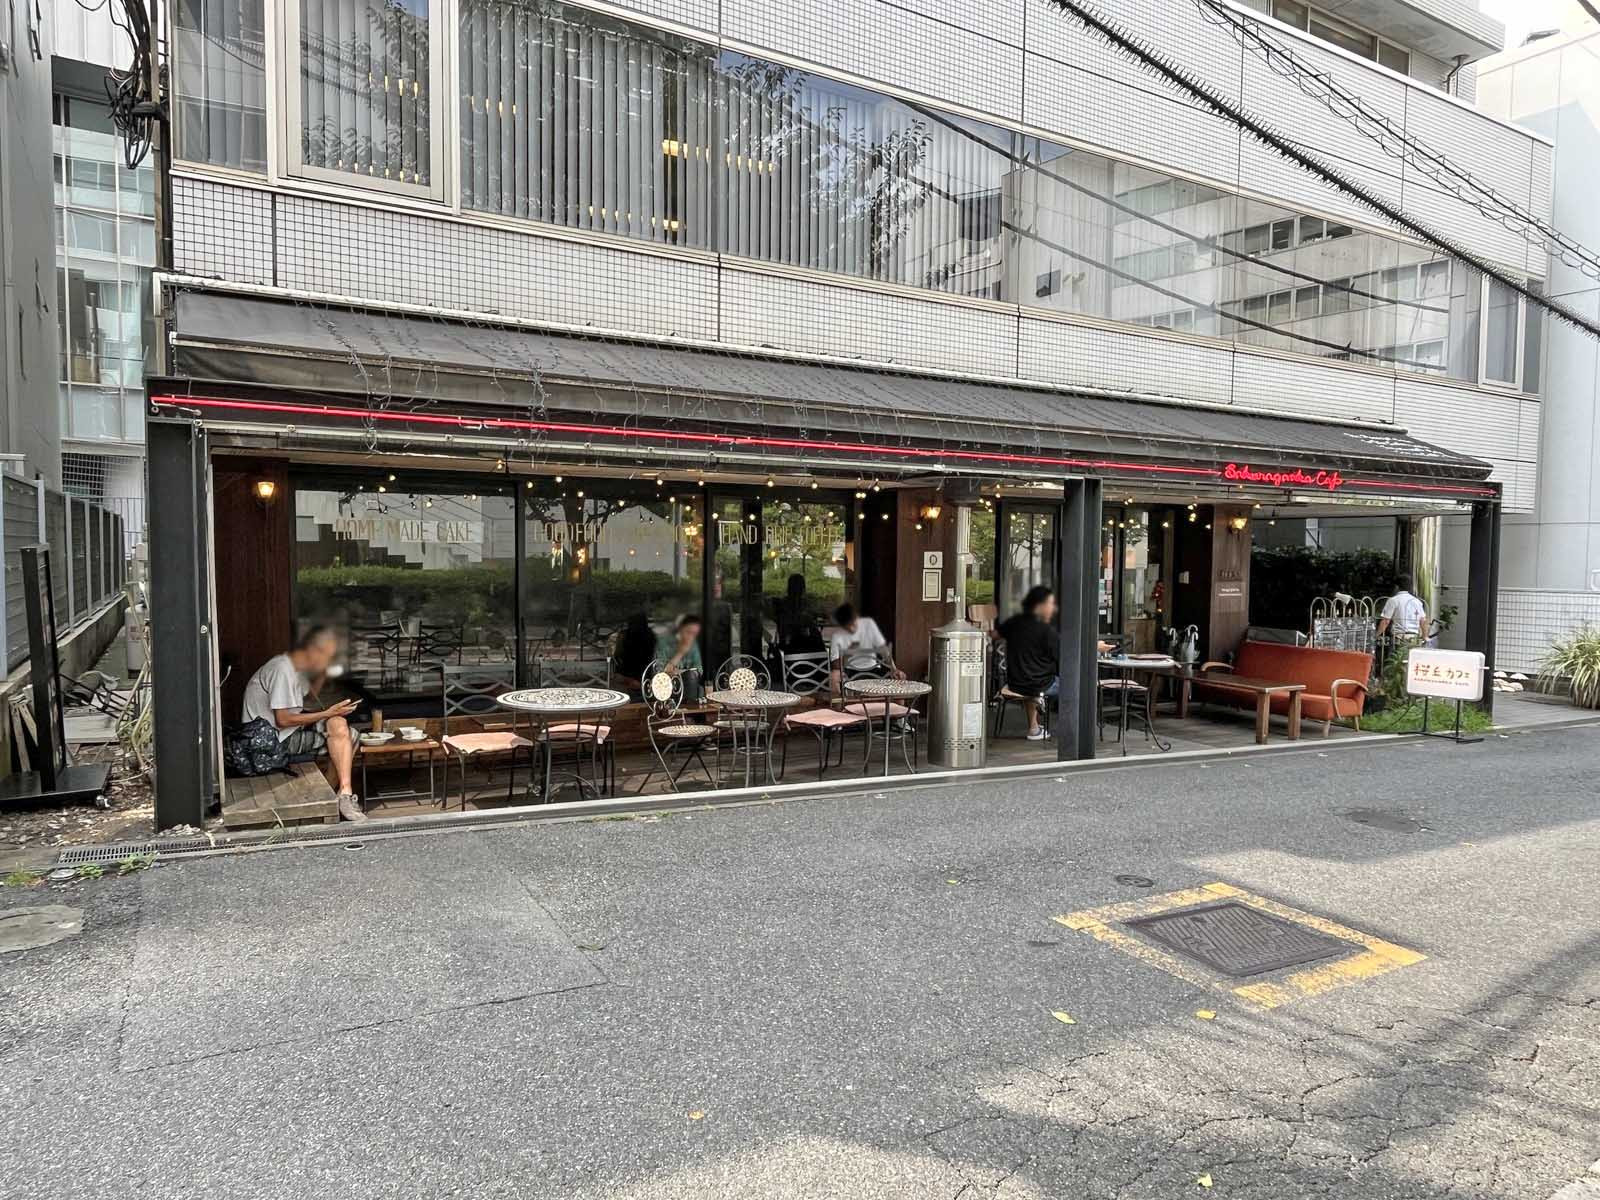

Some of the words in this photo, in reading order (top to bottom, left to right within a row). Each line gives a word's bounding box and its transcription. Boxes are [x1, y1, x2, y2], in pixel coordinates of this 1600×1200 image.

[336, 519, 380, 541] HOME
[385, 519, 429, 542] MADE
[437, 520, 473, 543] CAKE
[722, 524, 758, 545] HAND
